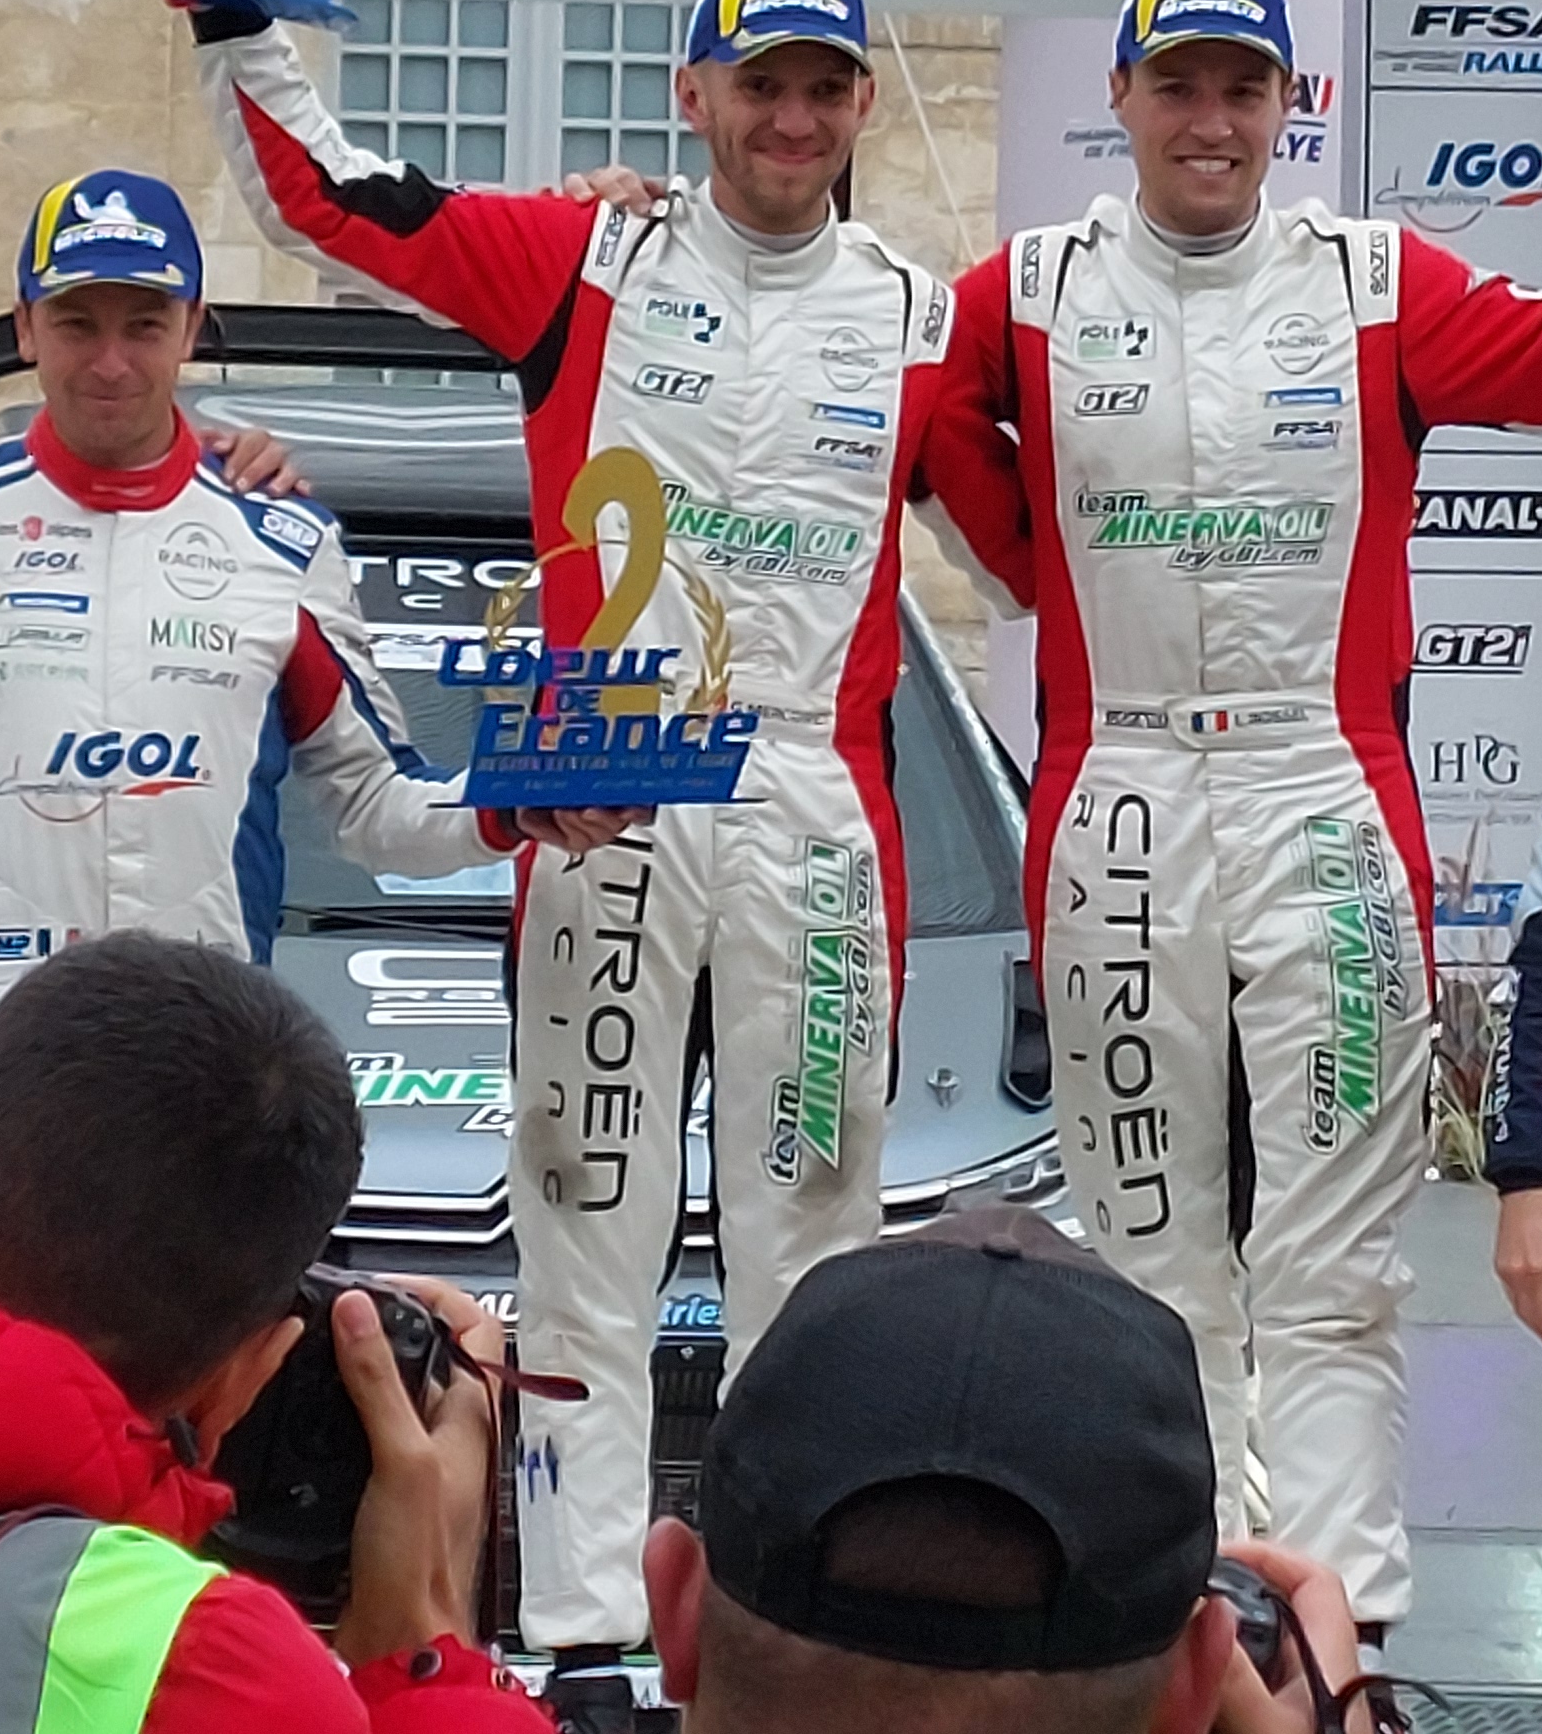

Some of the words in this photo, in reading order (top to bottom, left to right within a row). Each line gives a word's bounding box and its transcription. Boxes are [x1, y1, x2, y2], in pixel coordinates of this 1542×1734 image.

[1076, 486, 1146, 513] team
[259, 512, 320, 549] OMP
[665, 504, 796, 556] INERVA
[1096, 511, 1266, 546] MINERVA
[1277, 509, 1327, 543] OIL
[157, 549, 240, 576] RACING
[150, 616, 239, 656] MARSY
[1416, 626, 1534, 666] GT2i
[150, 666, 234, 690] FFSA
[436, 637, 684, 688] Coeur
[479, 700, 761, 756] France
[577, 834, 654, 1214] ITROËN
[1102, 792, 1173, 1239] CITROËN
[1325, 901, 1380, 1118] MINERVA
[801, 931, 850, 1159] MINERVA
[1305, 1050, 1337, 1151] team
[768, 1079, 801, 1181] team
